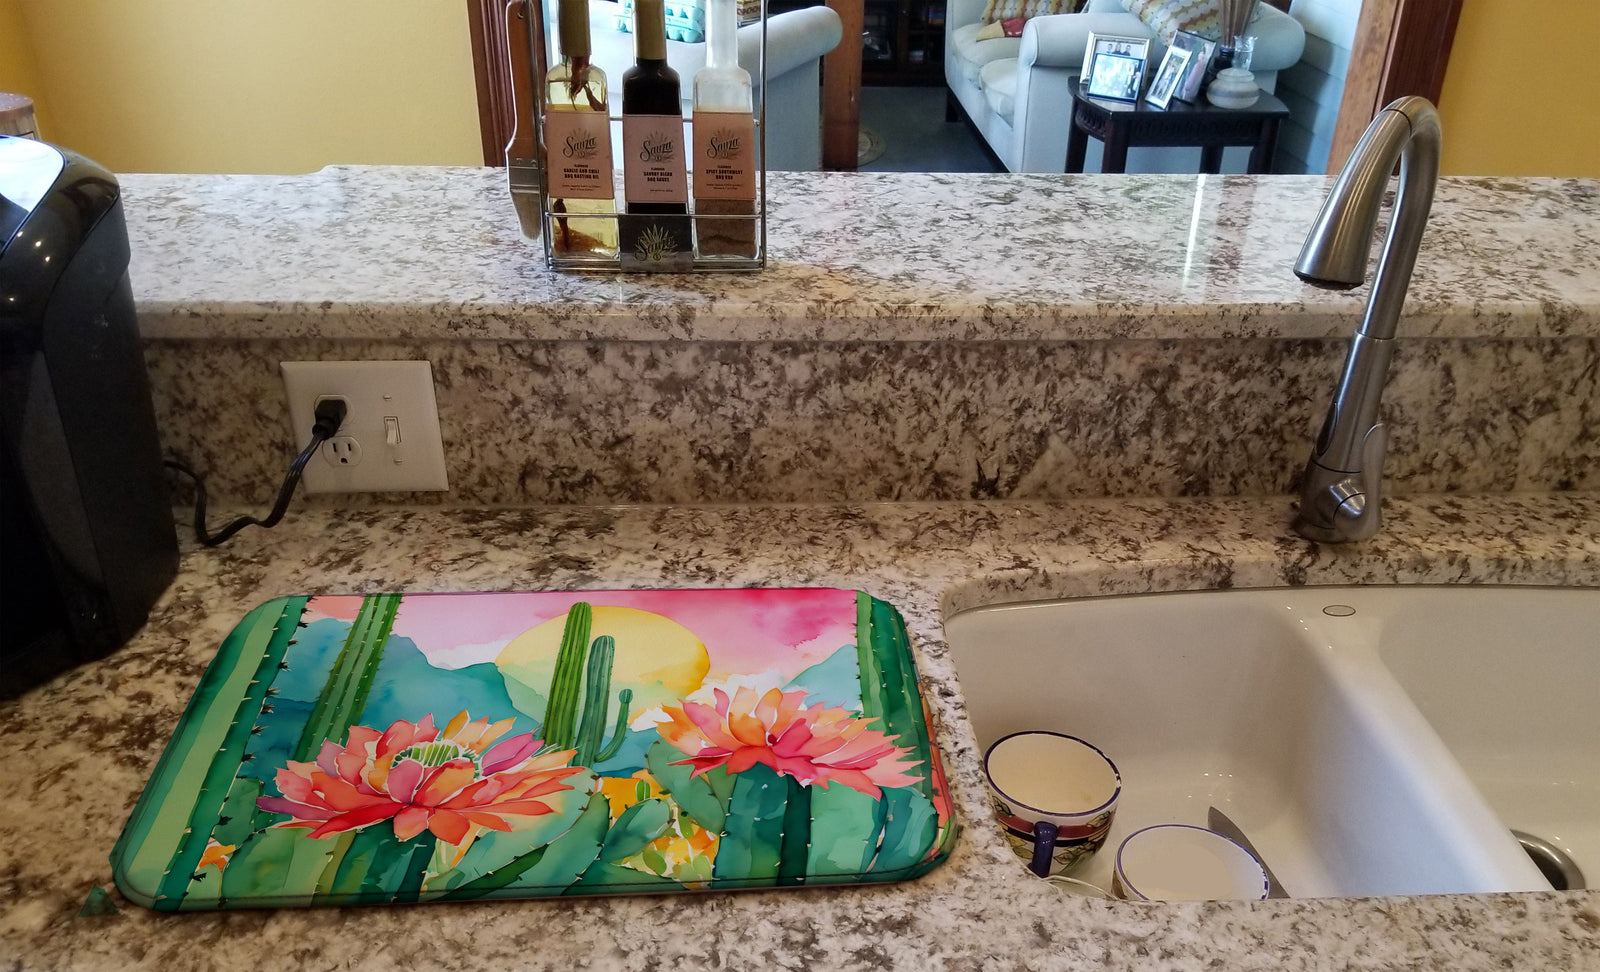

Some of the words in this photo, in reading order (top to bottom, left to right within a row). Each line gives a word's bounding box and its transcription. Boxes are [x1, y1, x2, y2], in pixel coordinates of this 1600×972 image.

[563, 135, 597, 158] Sauza
[640, 140, 674, 161] Sauza
[707, 136, 740, 159] Sauza
